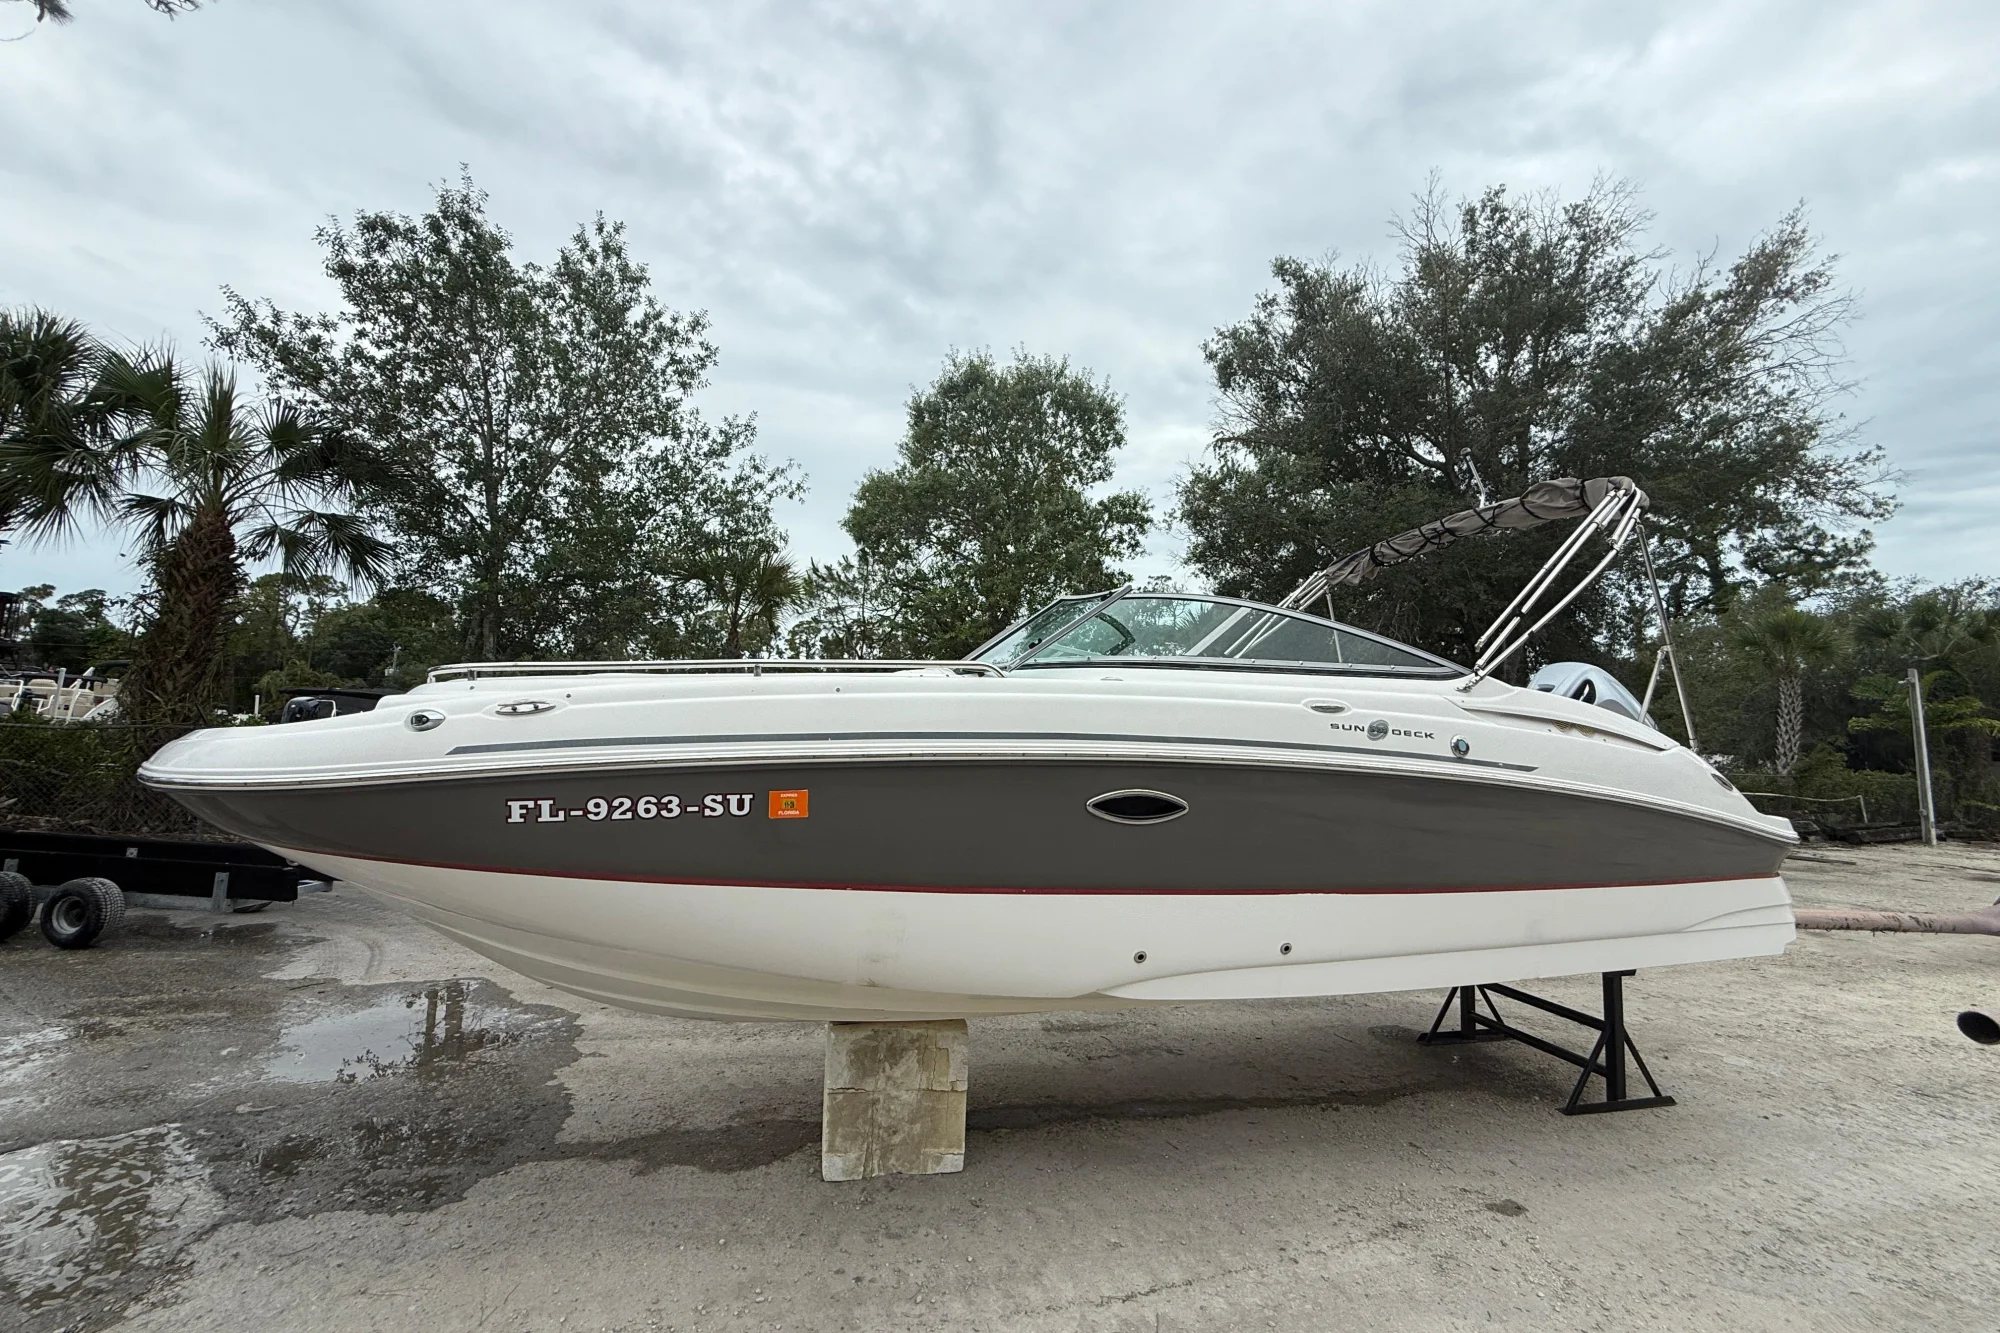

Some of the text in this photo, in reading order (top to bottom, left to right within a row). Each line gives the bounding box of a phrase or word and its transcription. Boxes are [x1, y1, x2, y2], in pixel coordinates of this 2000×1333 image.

[1330, 723, 1365, 732] SUN
[1391, 728, 1435, 740] DECK
[506, 793, 755, 823] FL-9263-SU
